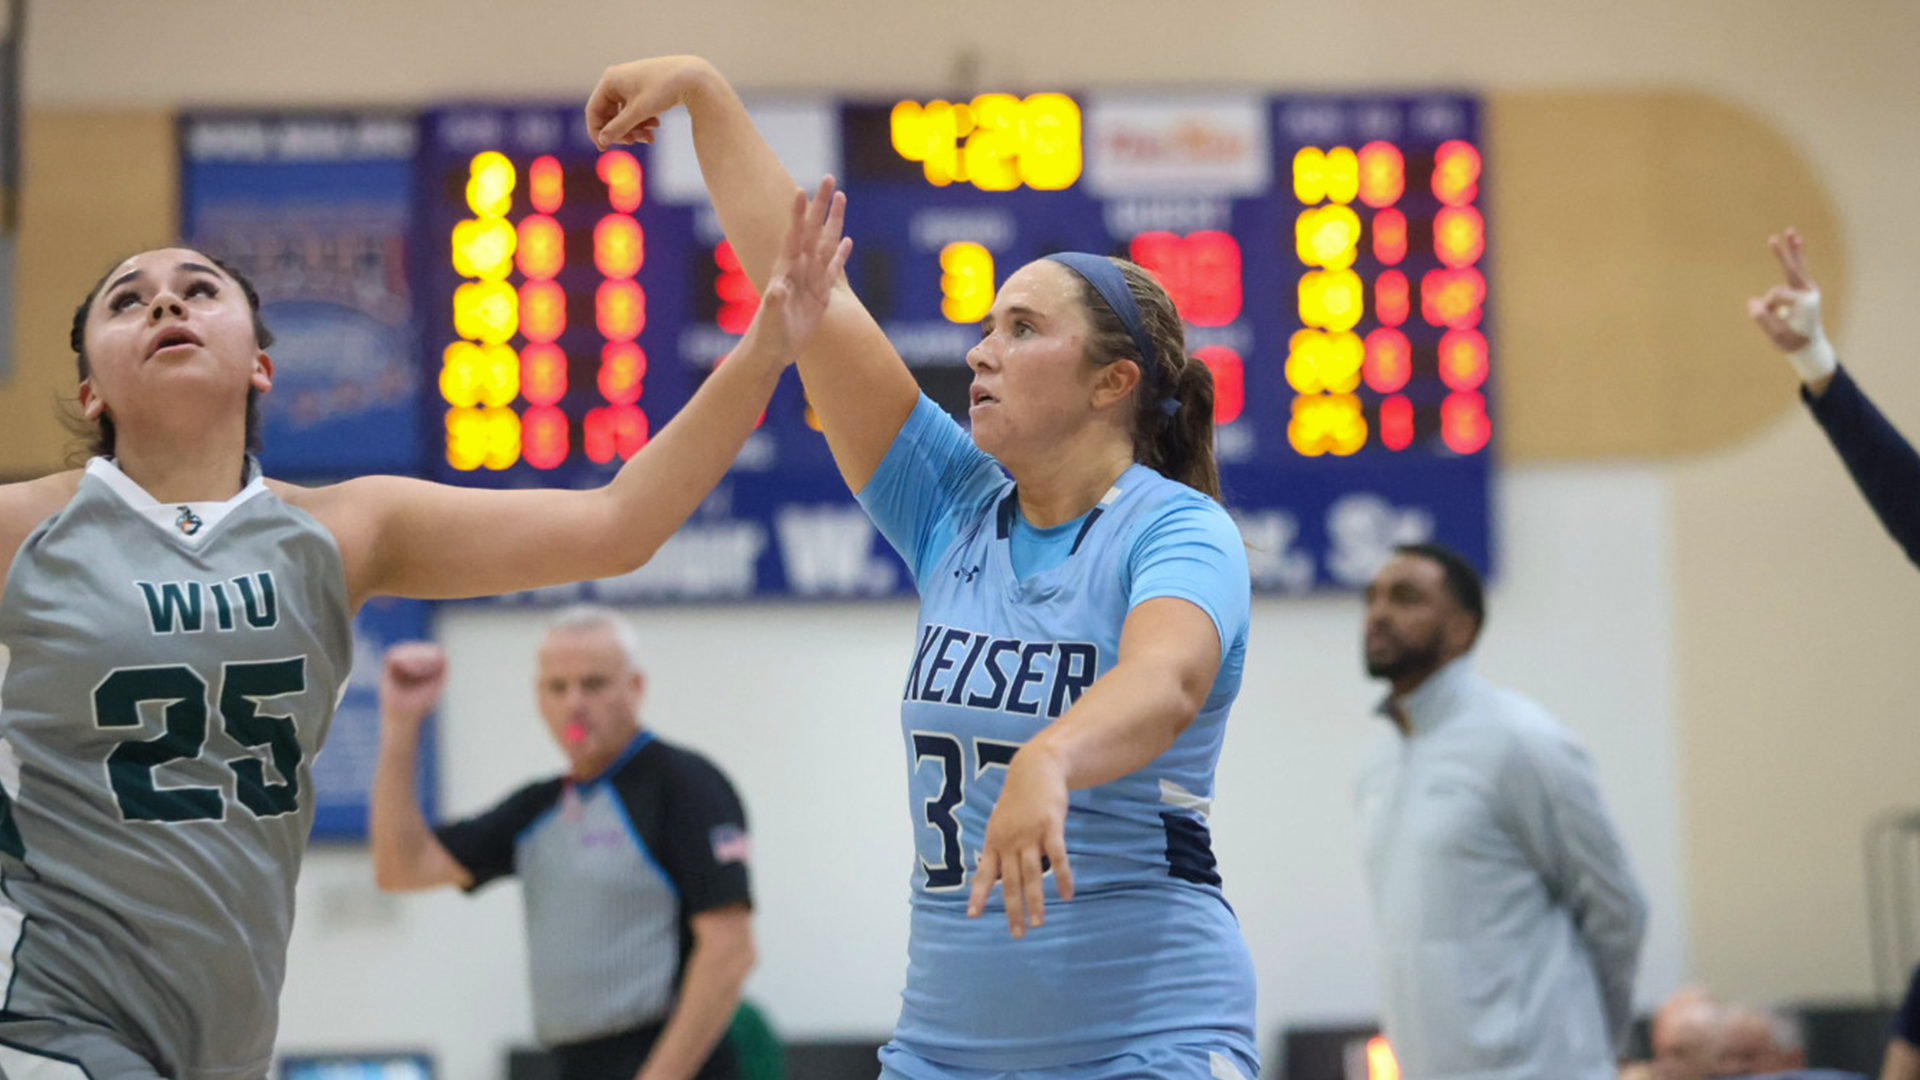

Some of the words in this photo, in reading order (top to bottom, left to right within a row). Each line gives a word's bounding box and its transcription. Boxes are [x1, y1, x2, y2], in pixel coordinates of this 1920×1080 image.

[133, 570, 278, 635] WIU
[904, 624, 1098, 718] KEISER
[90, 654, 307, 824] 25
[911, 730, 1056, 892] 3
